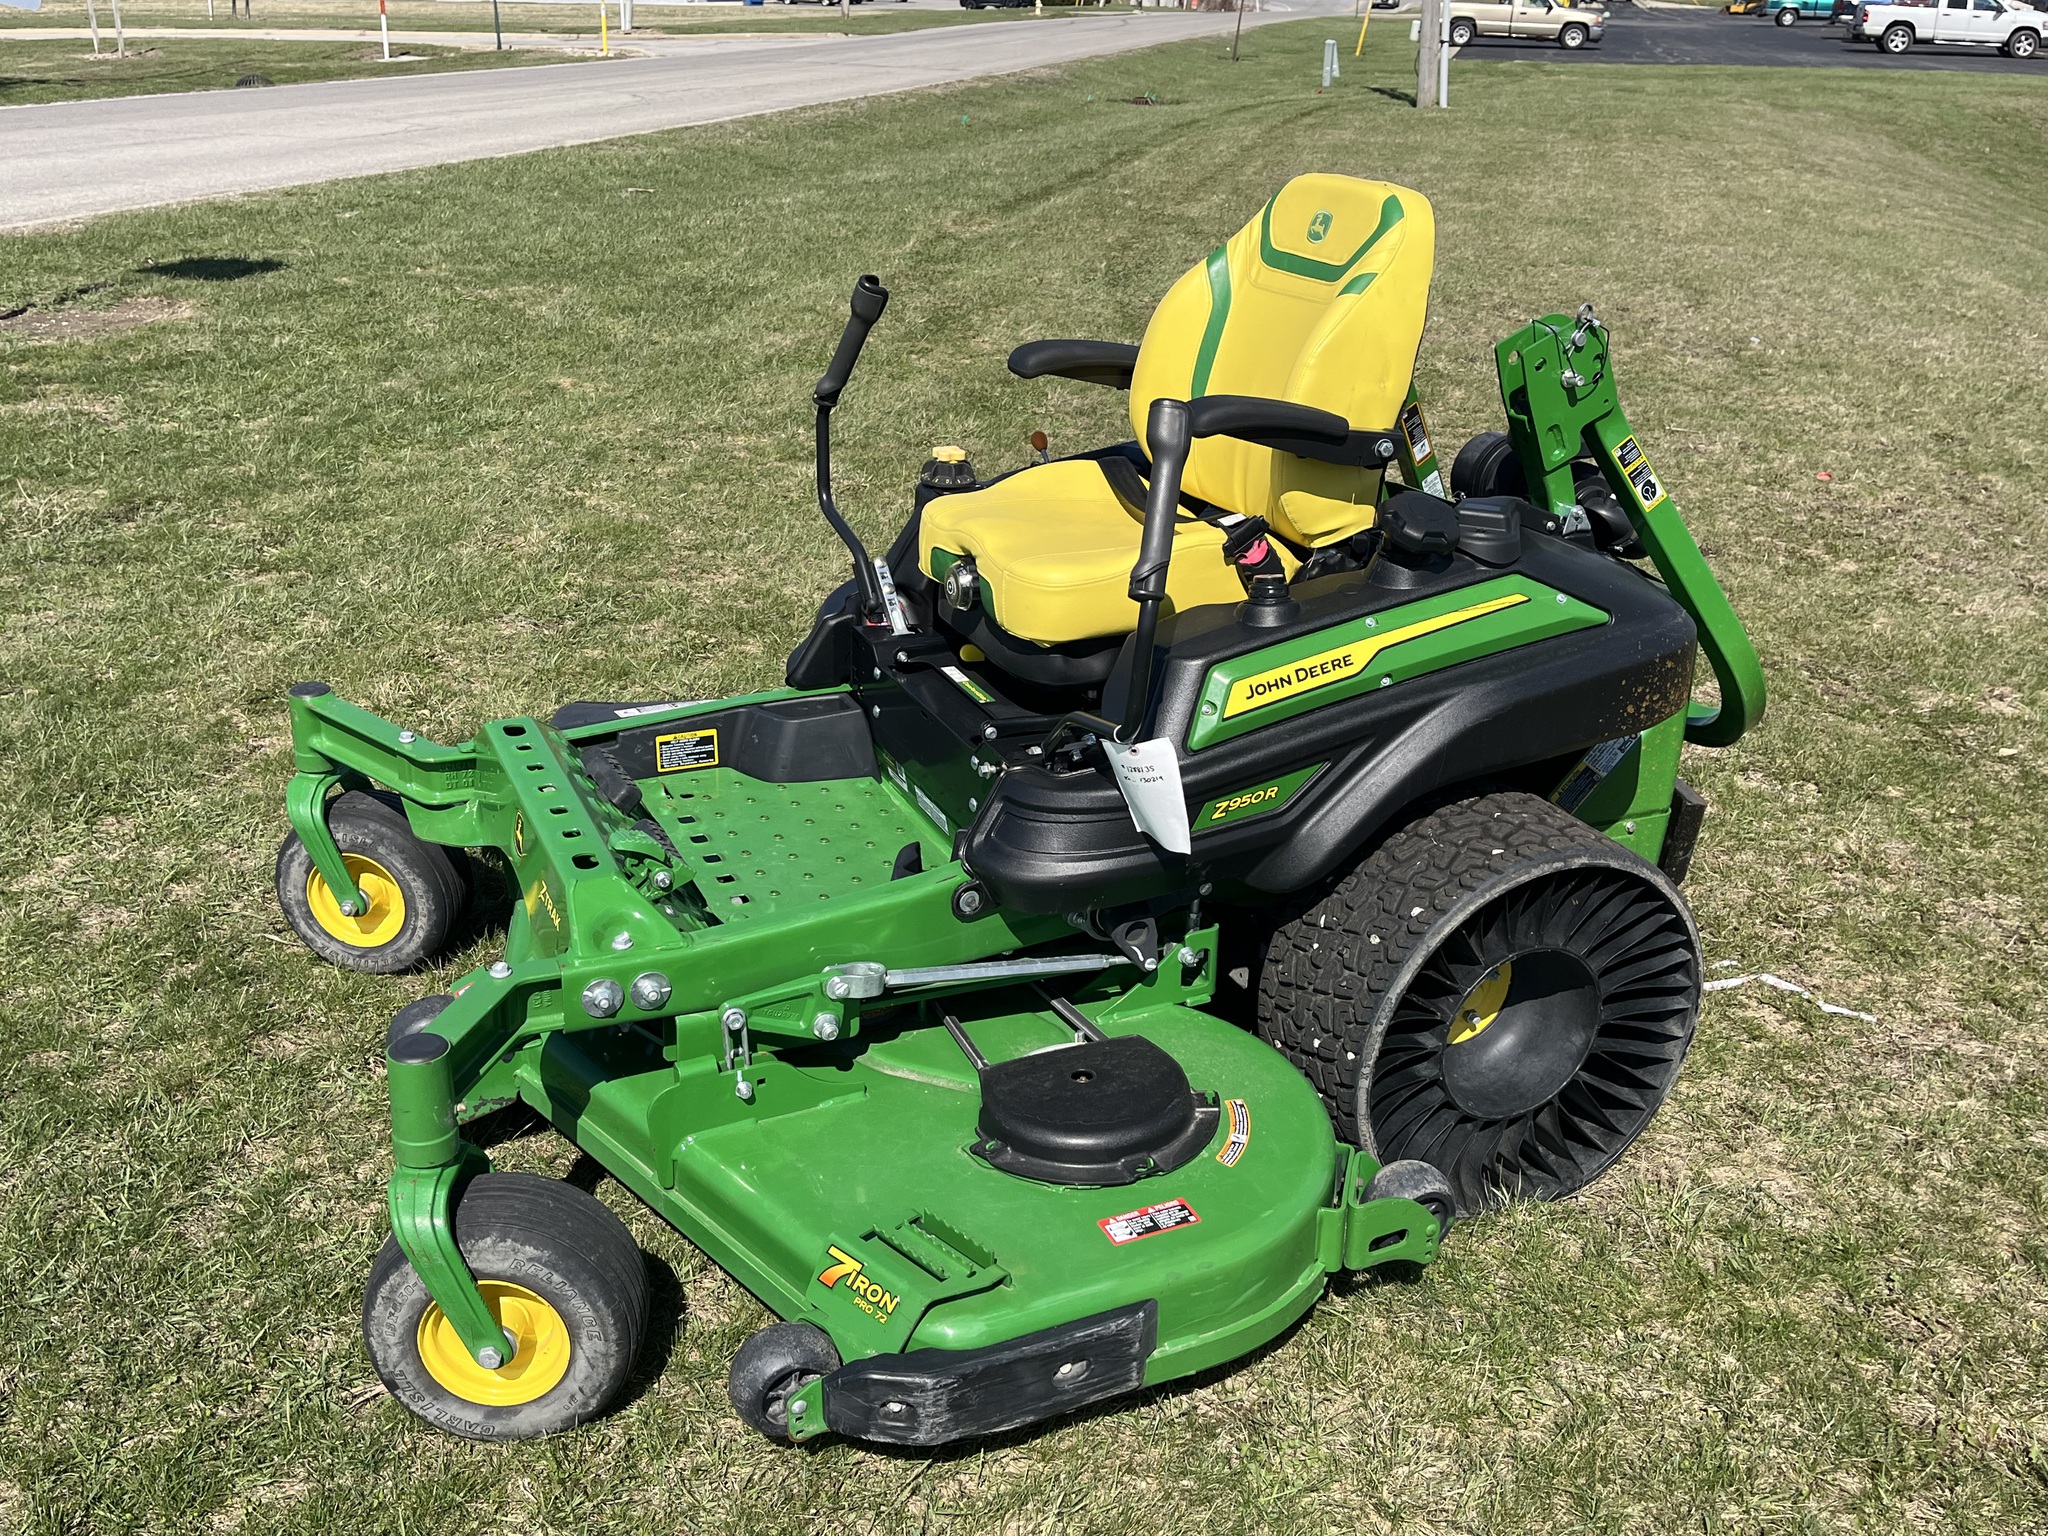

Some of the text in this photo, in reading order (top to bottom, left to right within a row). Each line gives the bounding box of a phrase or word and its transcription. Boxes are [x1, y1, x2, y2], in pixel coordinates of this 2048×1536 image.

[1246, 654, 1354, 700] JOHN DEERE
[1210, 786, 1279, 821] Z950R
[538, 880, 561, 932] ZTRAK
[509, 1258, 602, 1342] RELIANCE
[853, 1296, 888, 1324] PRO 72
[390, 1368, 496, 1436] CARLISLE
